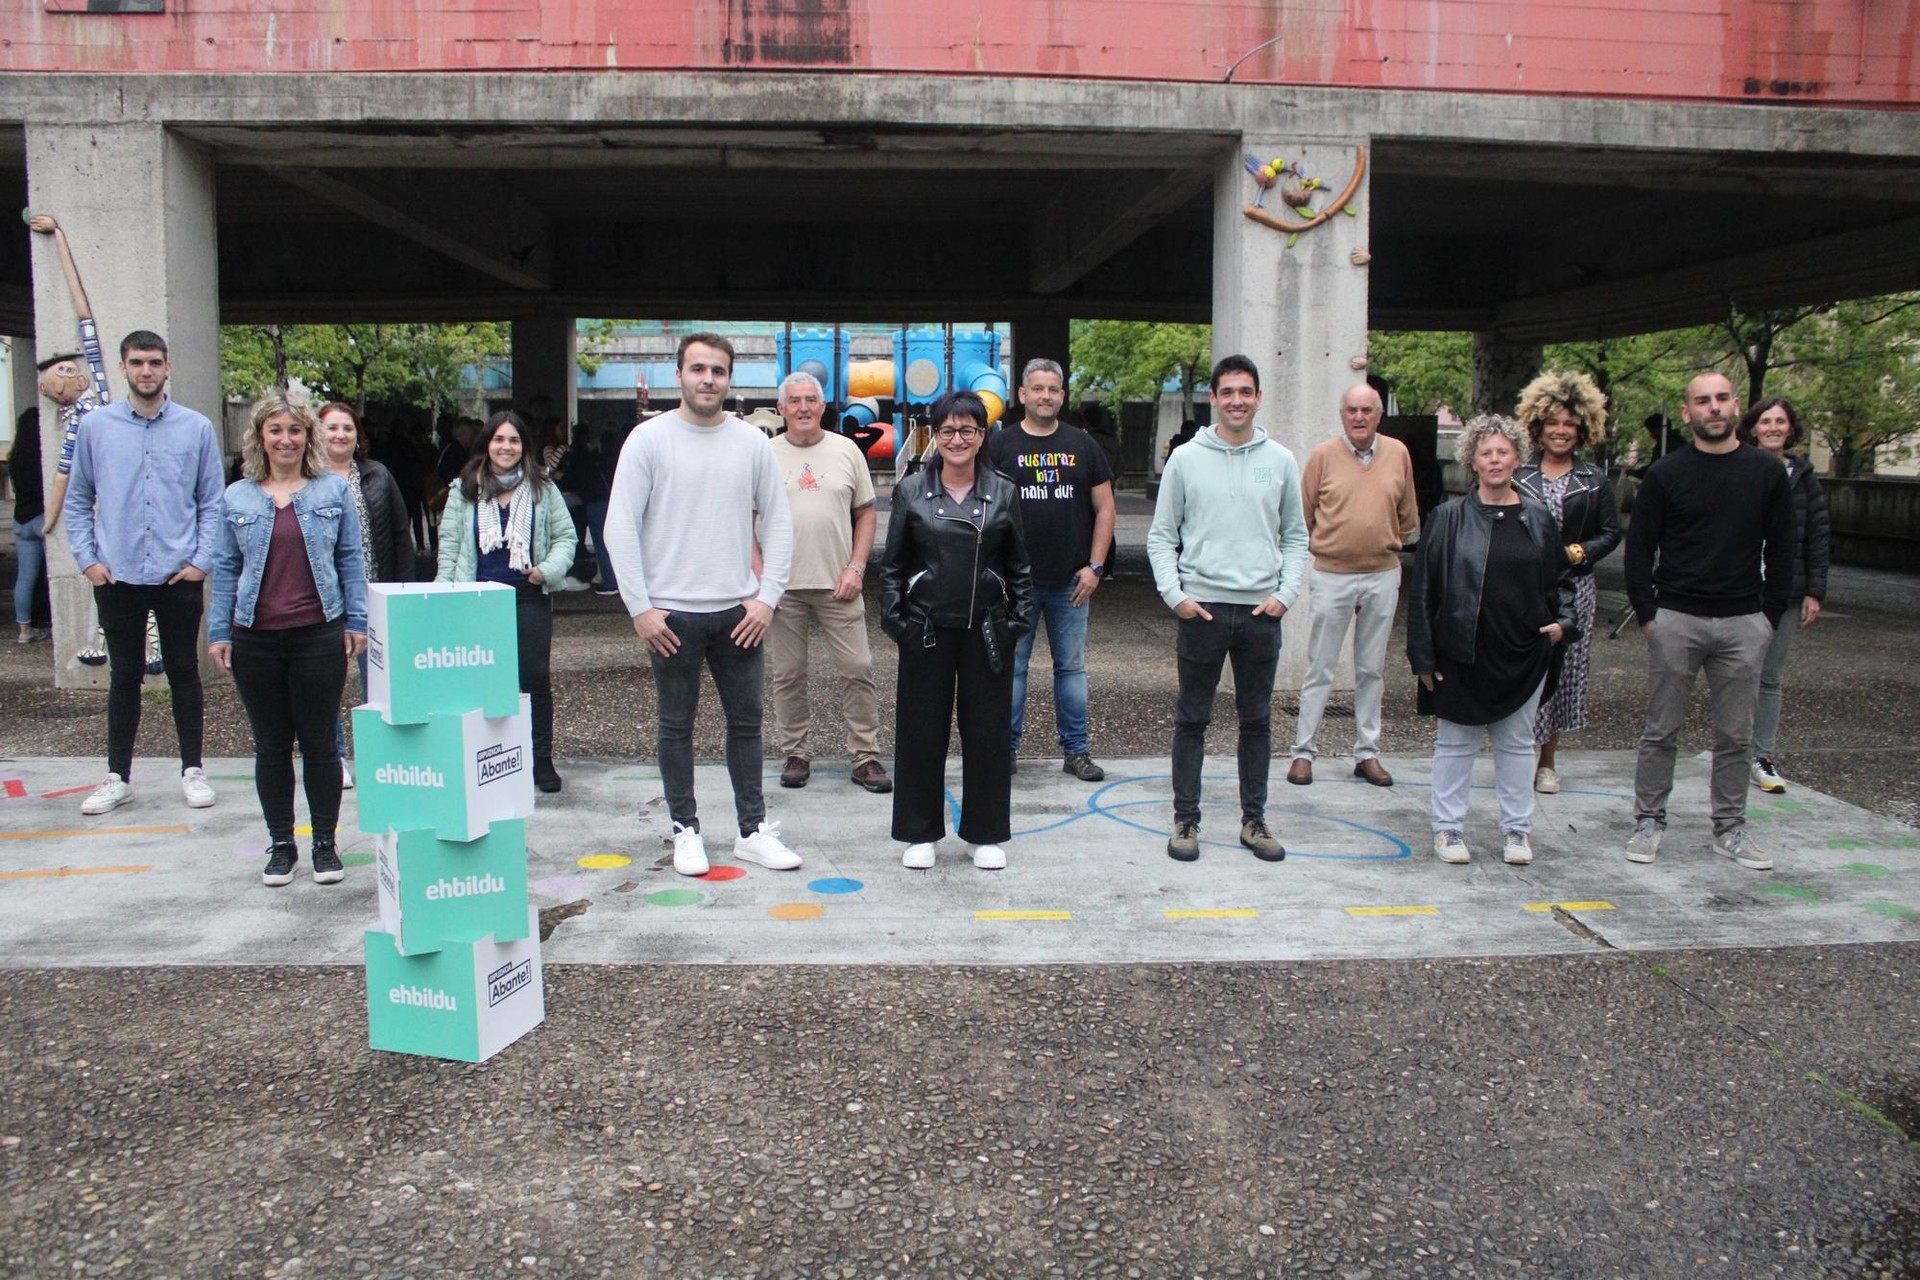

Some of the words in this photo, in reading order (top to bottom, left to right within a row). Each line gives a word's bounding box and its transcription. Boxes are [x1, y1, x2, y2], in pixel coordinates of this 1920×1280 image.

[1018, 453, 1075, 467] euskaraz
[1036, 469, 1060, 482] bizi
[1021, 485, 1048, 499] nahi
[1055, 484, 1074, 498] dut
[414, 645, 495, 669] ehbildu
[375, 763, 444, 787] ehbildu
[481, 752, 519, 780] Abante!
[425, 873, 505, 900] ehbildu
[493, 965, 529, 1000] Abante!
[389, 985, 457, 1011] ehbildu
